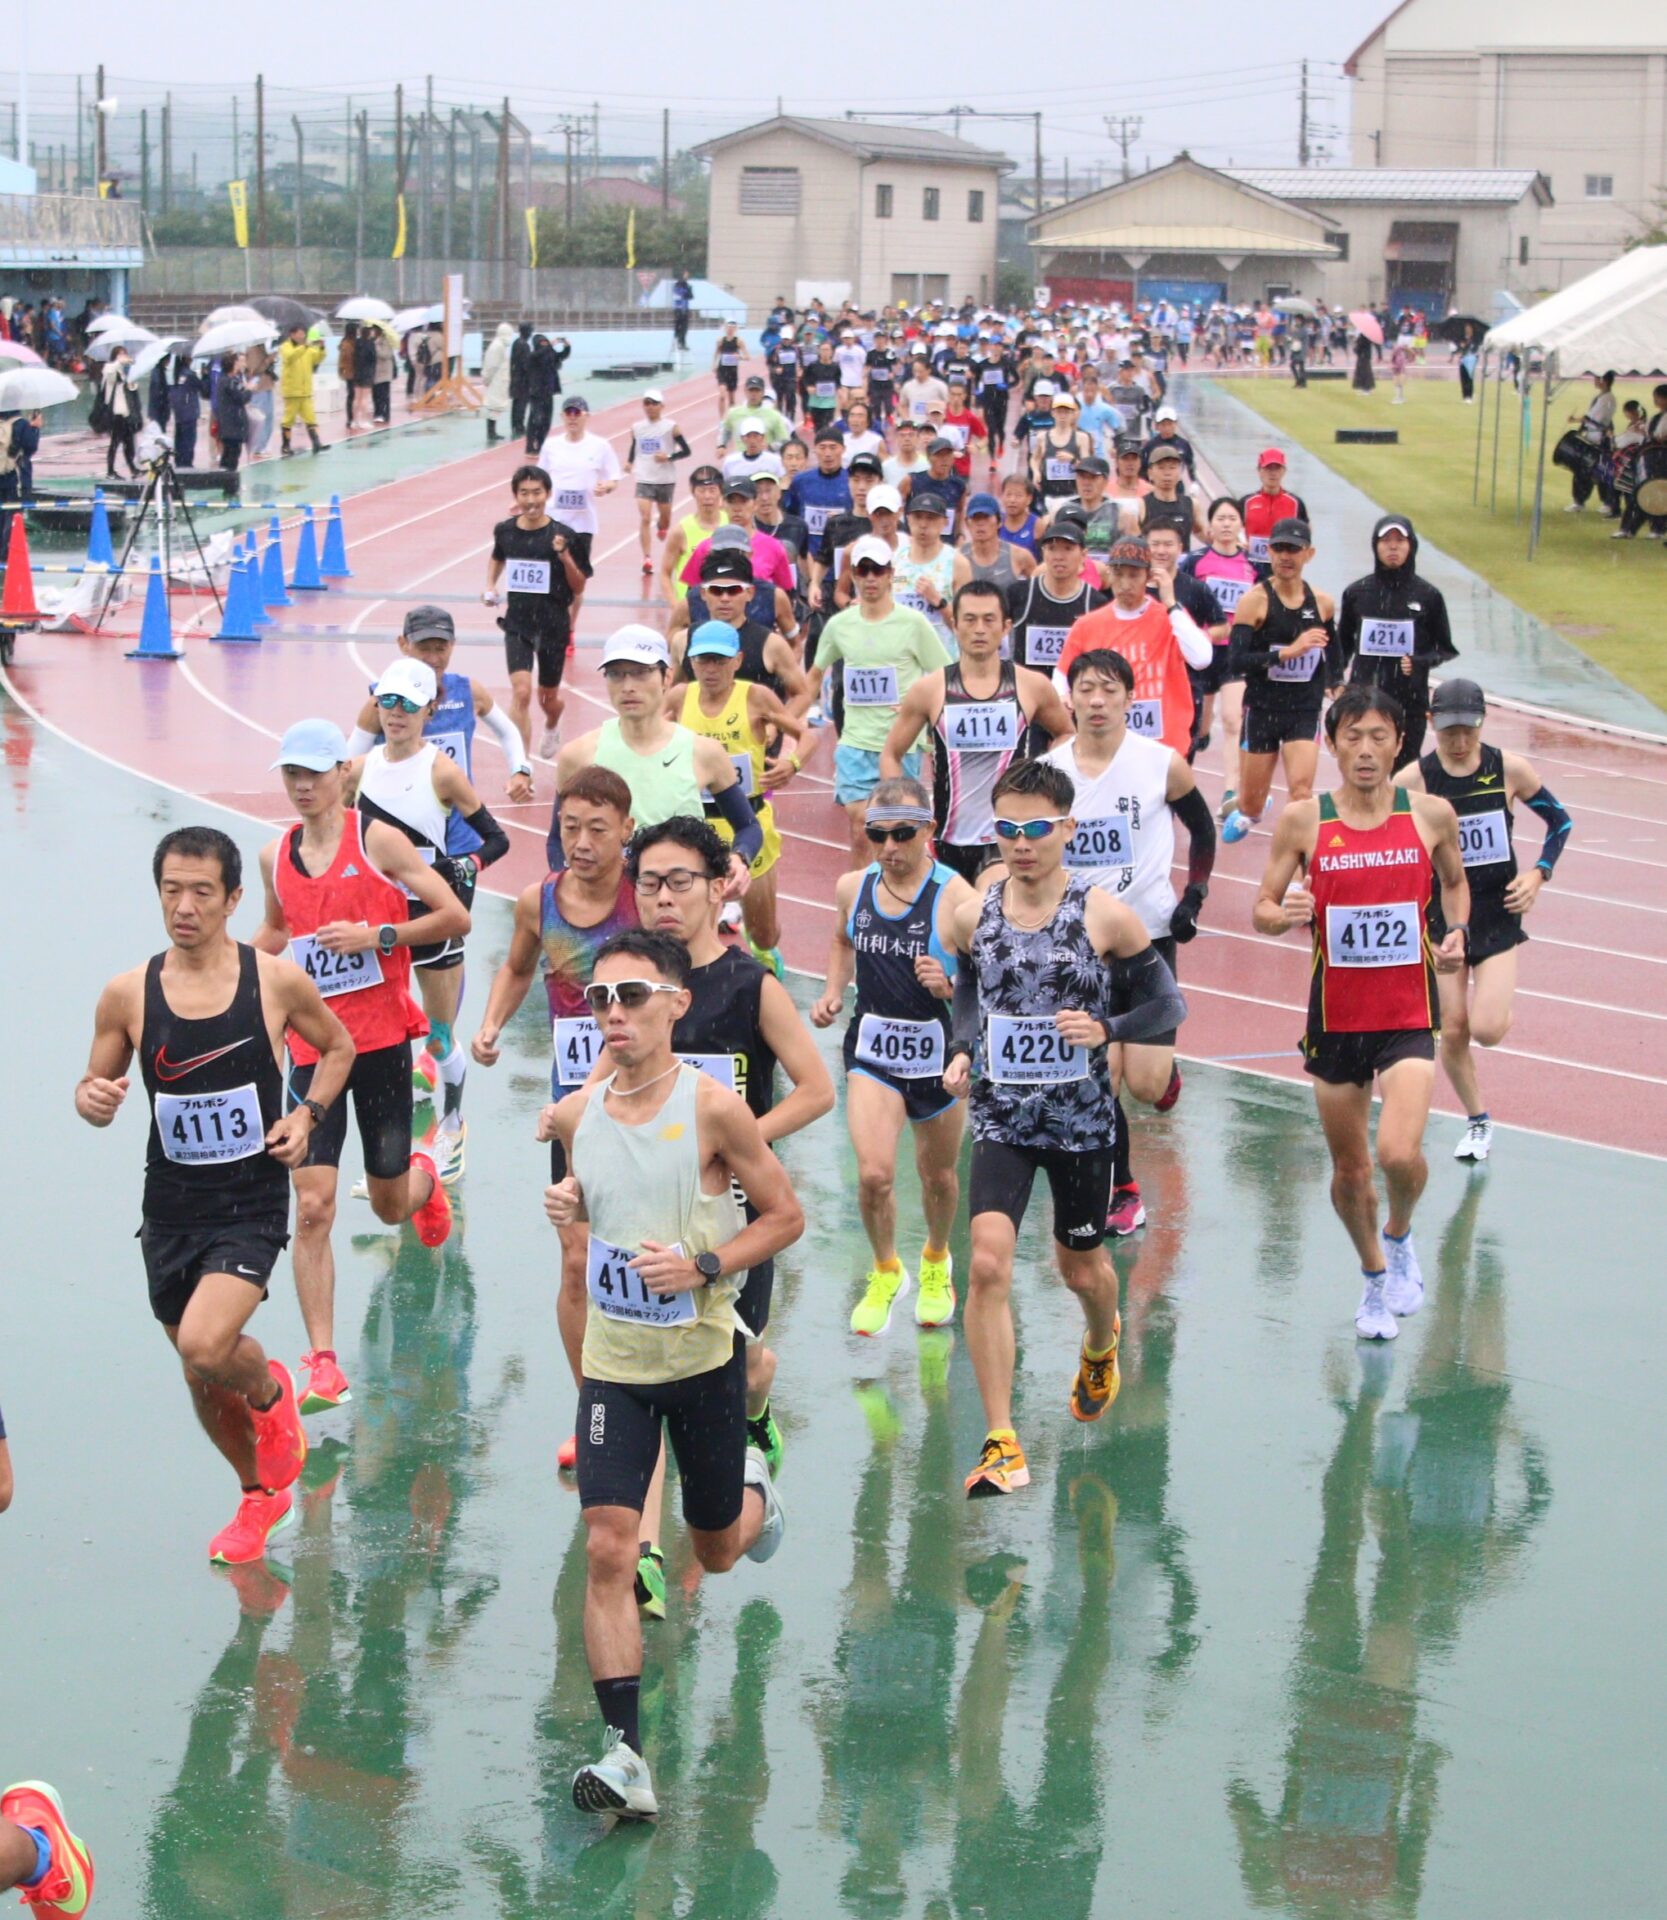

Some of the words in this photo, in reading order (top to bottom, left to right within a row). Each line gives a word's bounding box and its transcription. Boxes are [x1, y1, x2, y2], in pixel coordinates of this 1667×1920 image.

[511, 568, 544, 584] 4162
[1034, 637, 1065, 655] 423
[1368, 630, 1407, 646] 4214
[850, 676, 888, 694] 4117
[955, 716, 1007, 738] 4114
[1124, 710, 1155, 730] 204
[1064, 828, 1122, 856] 4208
[1457, 825, 1495, 853] 001
[1319, 848, 1419, 872] KASHIWAZAKI
[1351, 909, 1394, 920] ブルボン
[1340, 919, 1409, 950] 4122
[881, 1022, 923, 1034] ブルボン
[869, 1032, 934, 1062] 4059
[1001, 1034, 1075, 1064] 4220
[179, 1098, 228, 1111] ブルボン
[172, 1107, 249, 1144] 4113
[589, 1403, 606, 1445] 2XU
